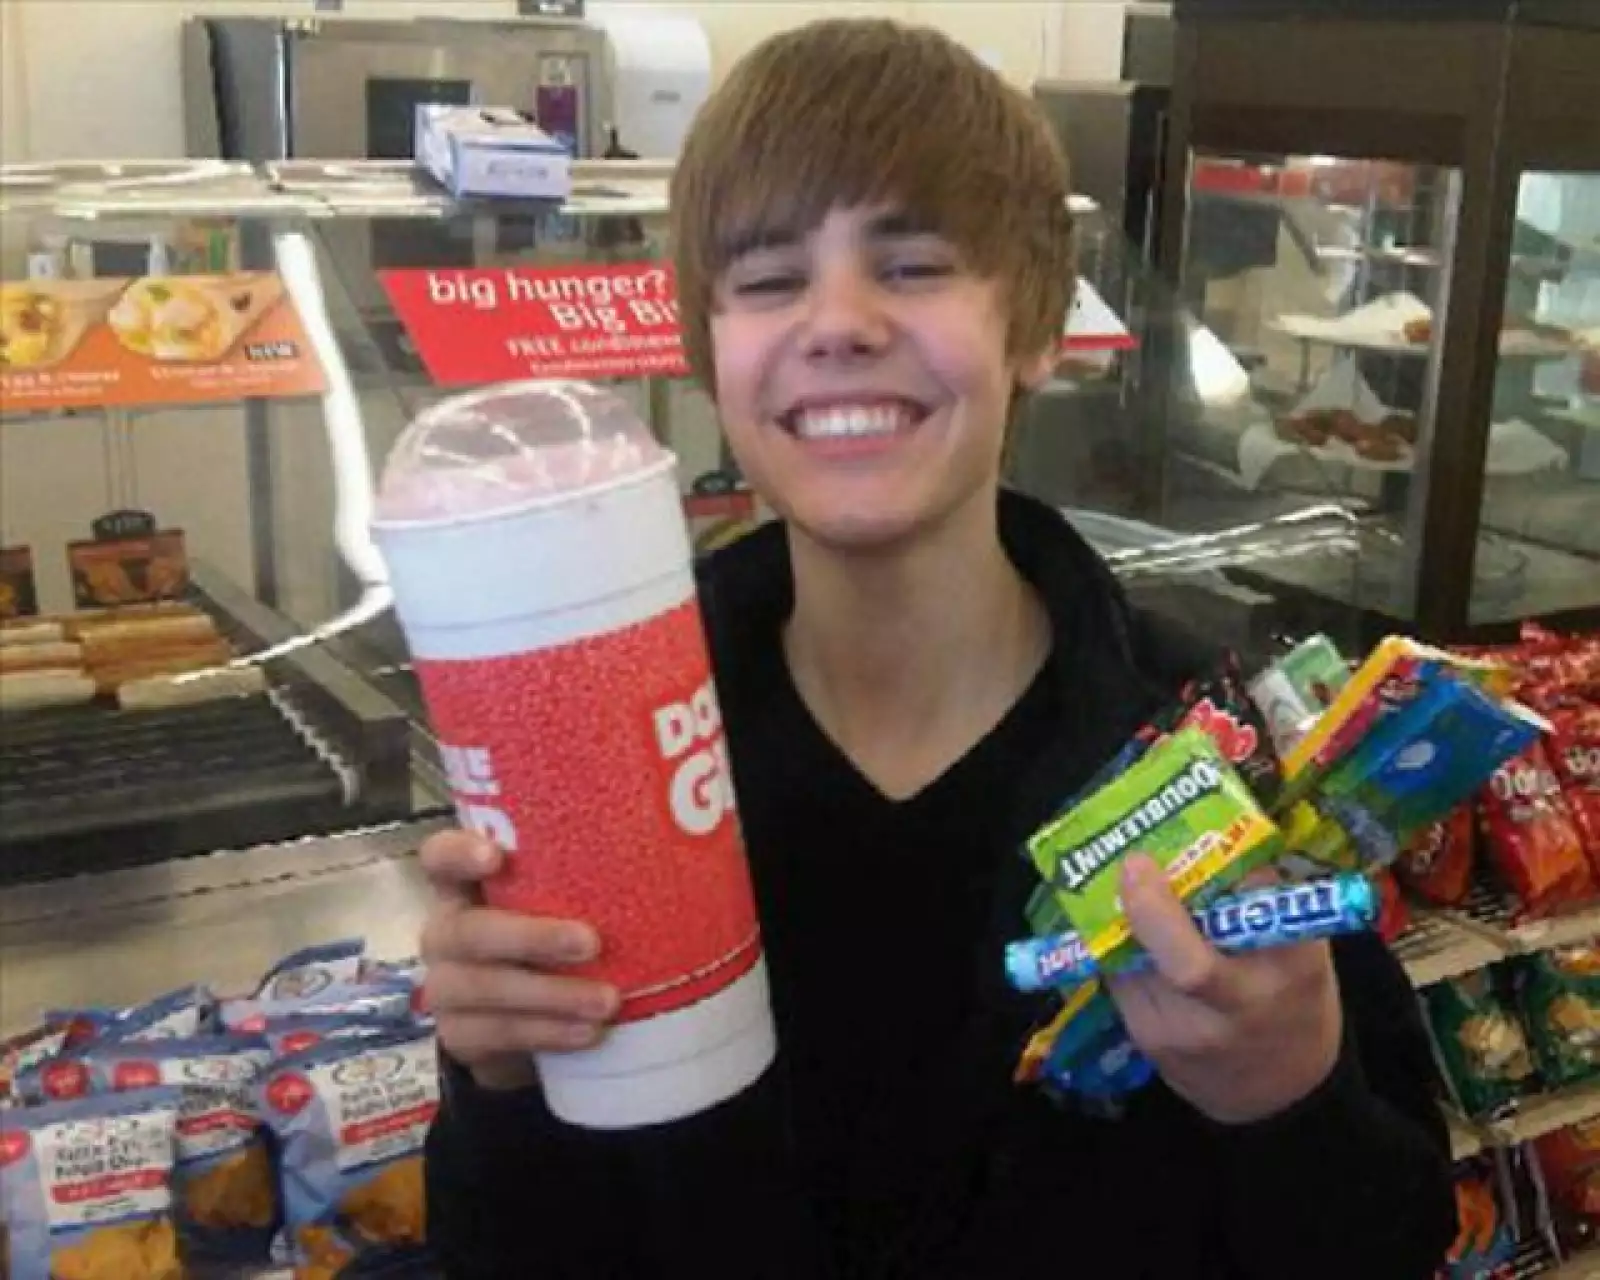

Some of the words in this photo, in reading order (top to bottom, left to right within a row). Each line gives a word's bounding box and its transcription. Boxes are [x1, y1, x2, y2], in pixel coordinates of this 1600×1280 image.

[427, 271, 497, 310] big
[505, 268, 667, 306] hunger?
[549, 300, 628, 333] Big
[629, 297, 680, 326] Bi
[1061, 758, 1221, 890] DOUBLEMINT
